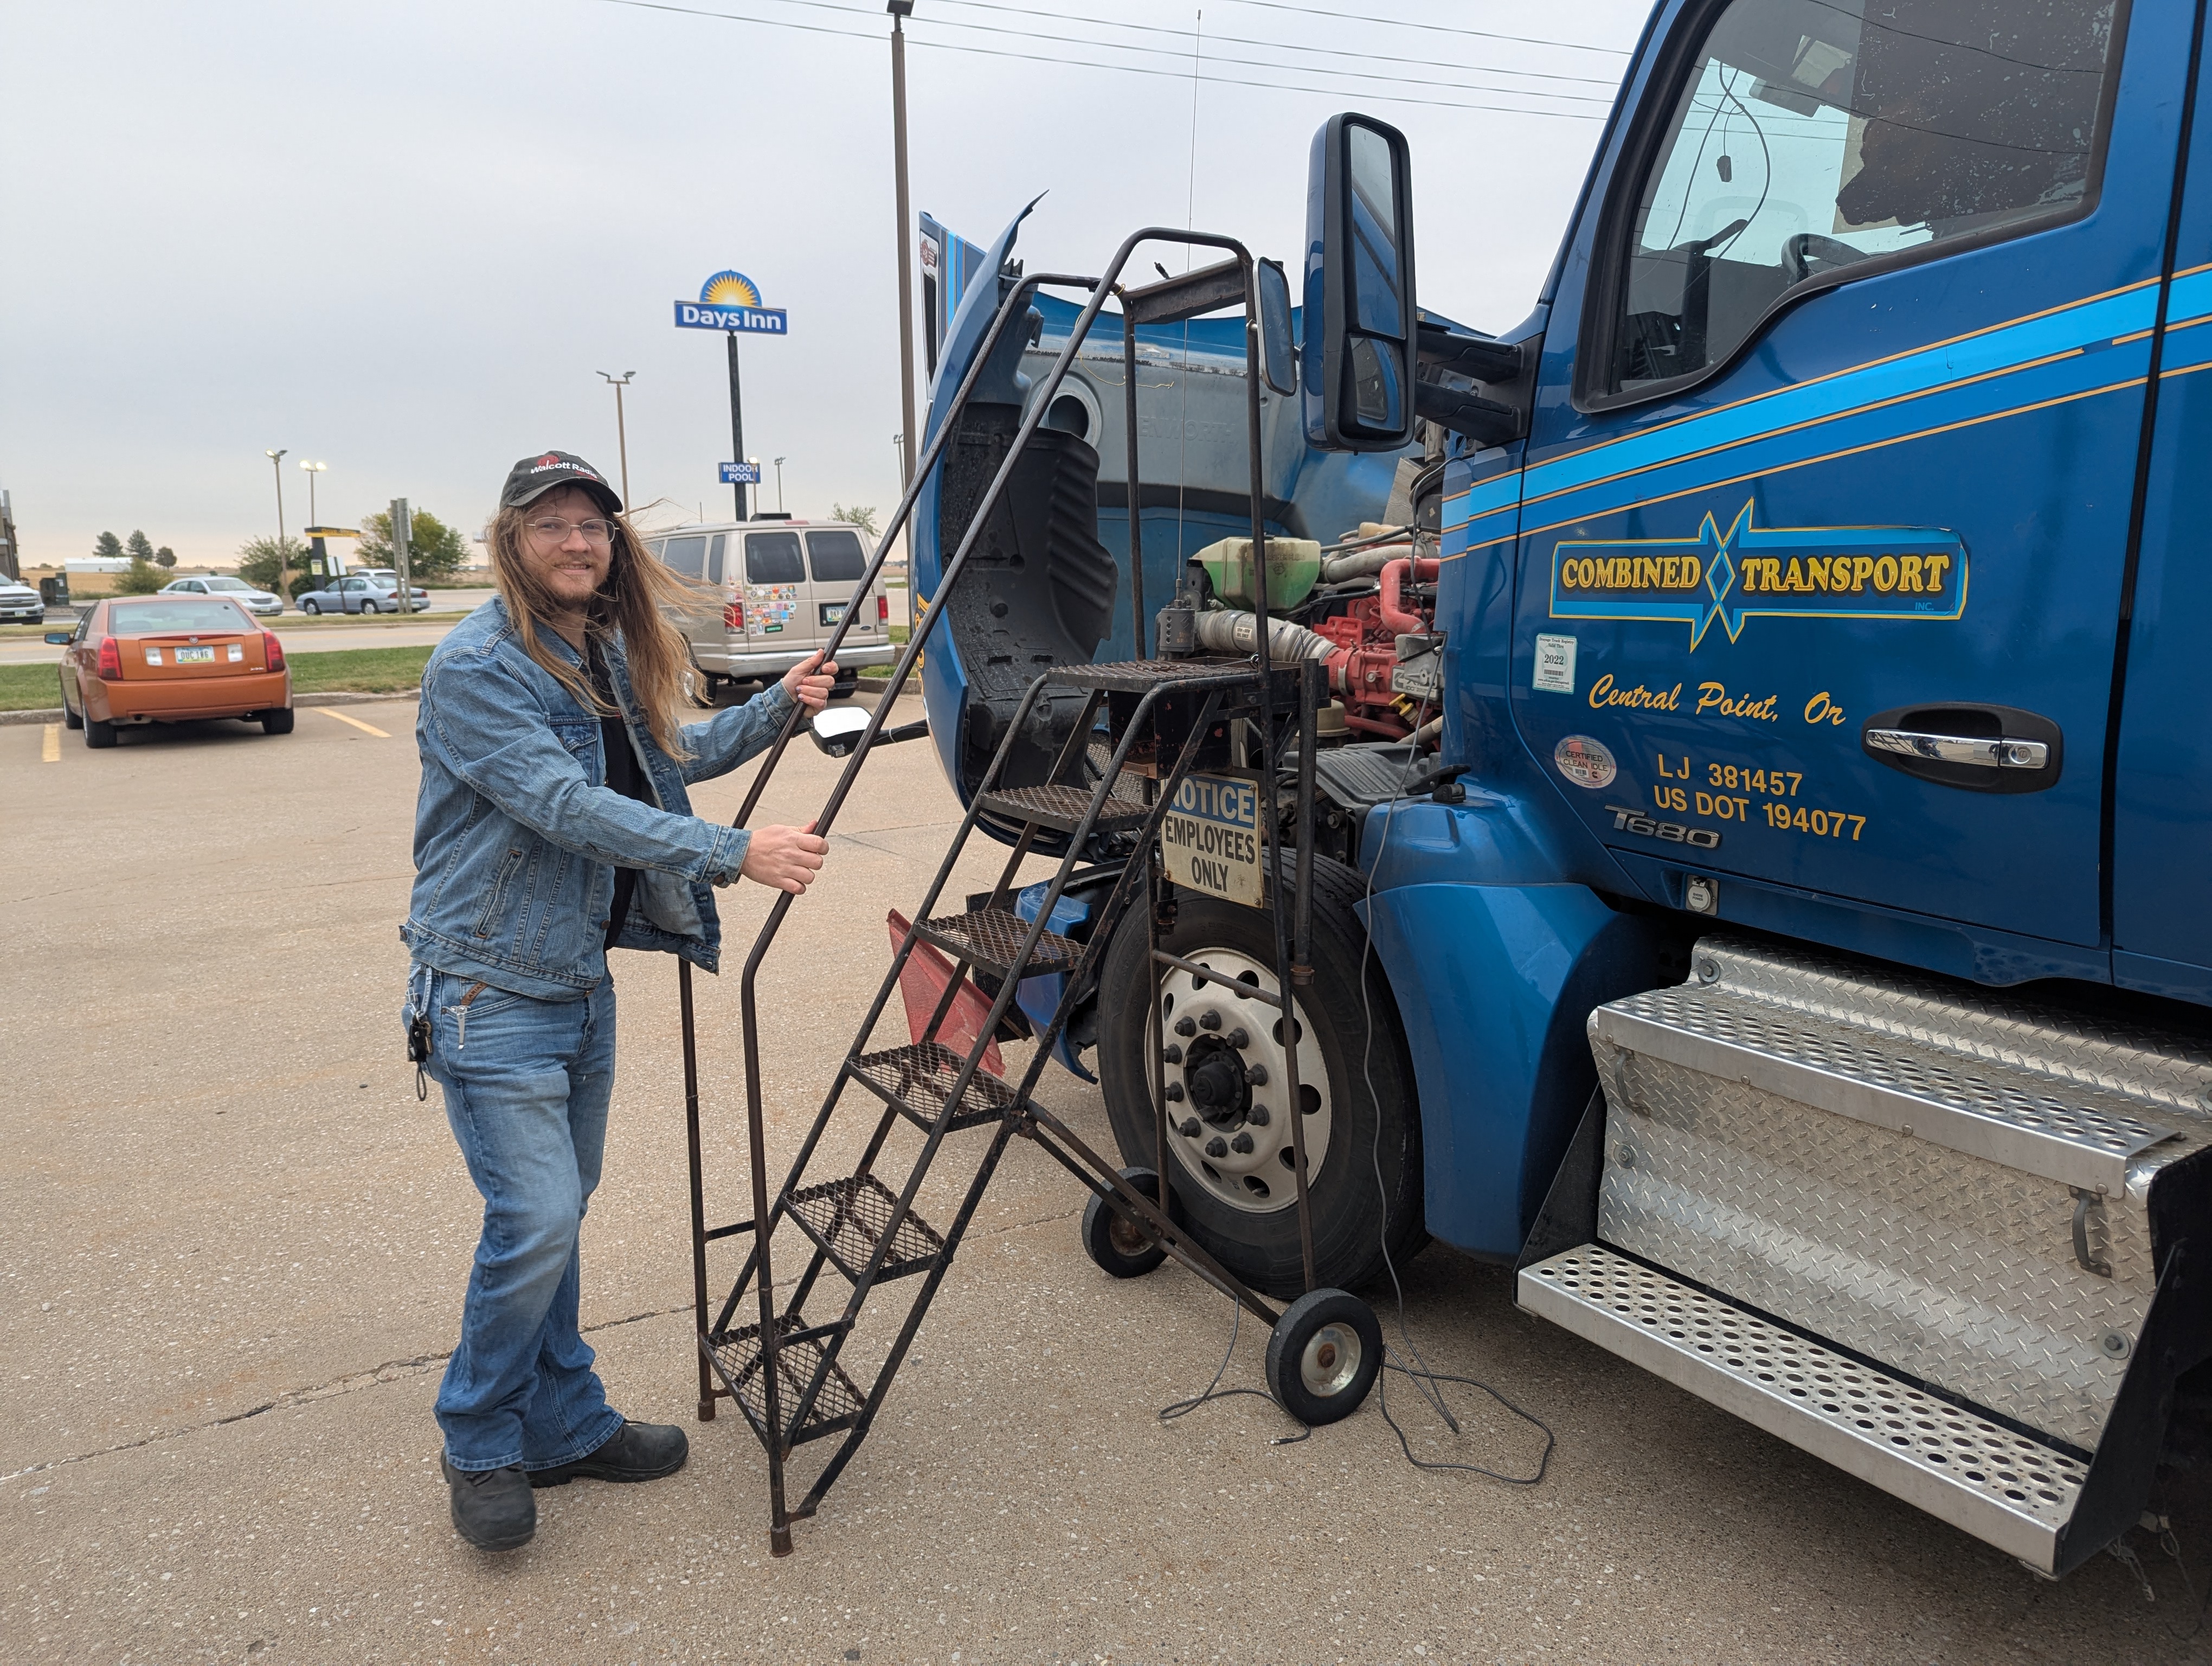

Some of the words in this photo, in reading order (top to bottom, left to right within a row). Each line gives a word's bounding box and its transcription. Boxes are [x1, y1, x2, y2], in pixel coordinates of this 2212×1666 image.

[683, 305, 740, 328] Days
[743, 310, 781, 330] Inn
[1138, 415, 1236, 444] ENWORTH
[530, 460, 571, 474] Walcott
[572, 463, 597, 479] Radio
[729, 473, 754, 482] POOL
[1562, 556, 1701, 588] COMBINED
[1741, 555, 1950, 592] TRANSPORT
[1914, 601, 1934, 611] INC.
[1544, 653, 1564, 665] 2022
[1589, 674, 1682, 711] Central
[1695, 682, 1779, 722] Point,
[1804, 691, 1847, 726] Or
[1563, 759, 1588, 768] CLEAN
[1591, 762, 1608, 772] IDLE
[1565, 750, 1603, 762] CERTIFIED
[1657, 754, 1690, 780] LJ
[1708, 763, 1803, 796] 381457
[1604, 804, 1722, 849] T680
[1654, 785, 1687, 811] US
[1695, 791, 1750, 822] DOT
[1762, 802, 1866, 841] 194077
[1165, 815, 1256, 864] EMPLOYEES
[1191, 856, 1229, 893] ONLY
[468, 982, 484, 998] ARIAT
